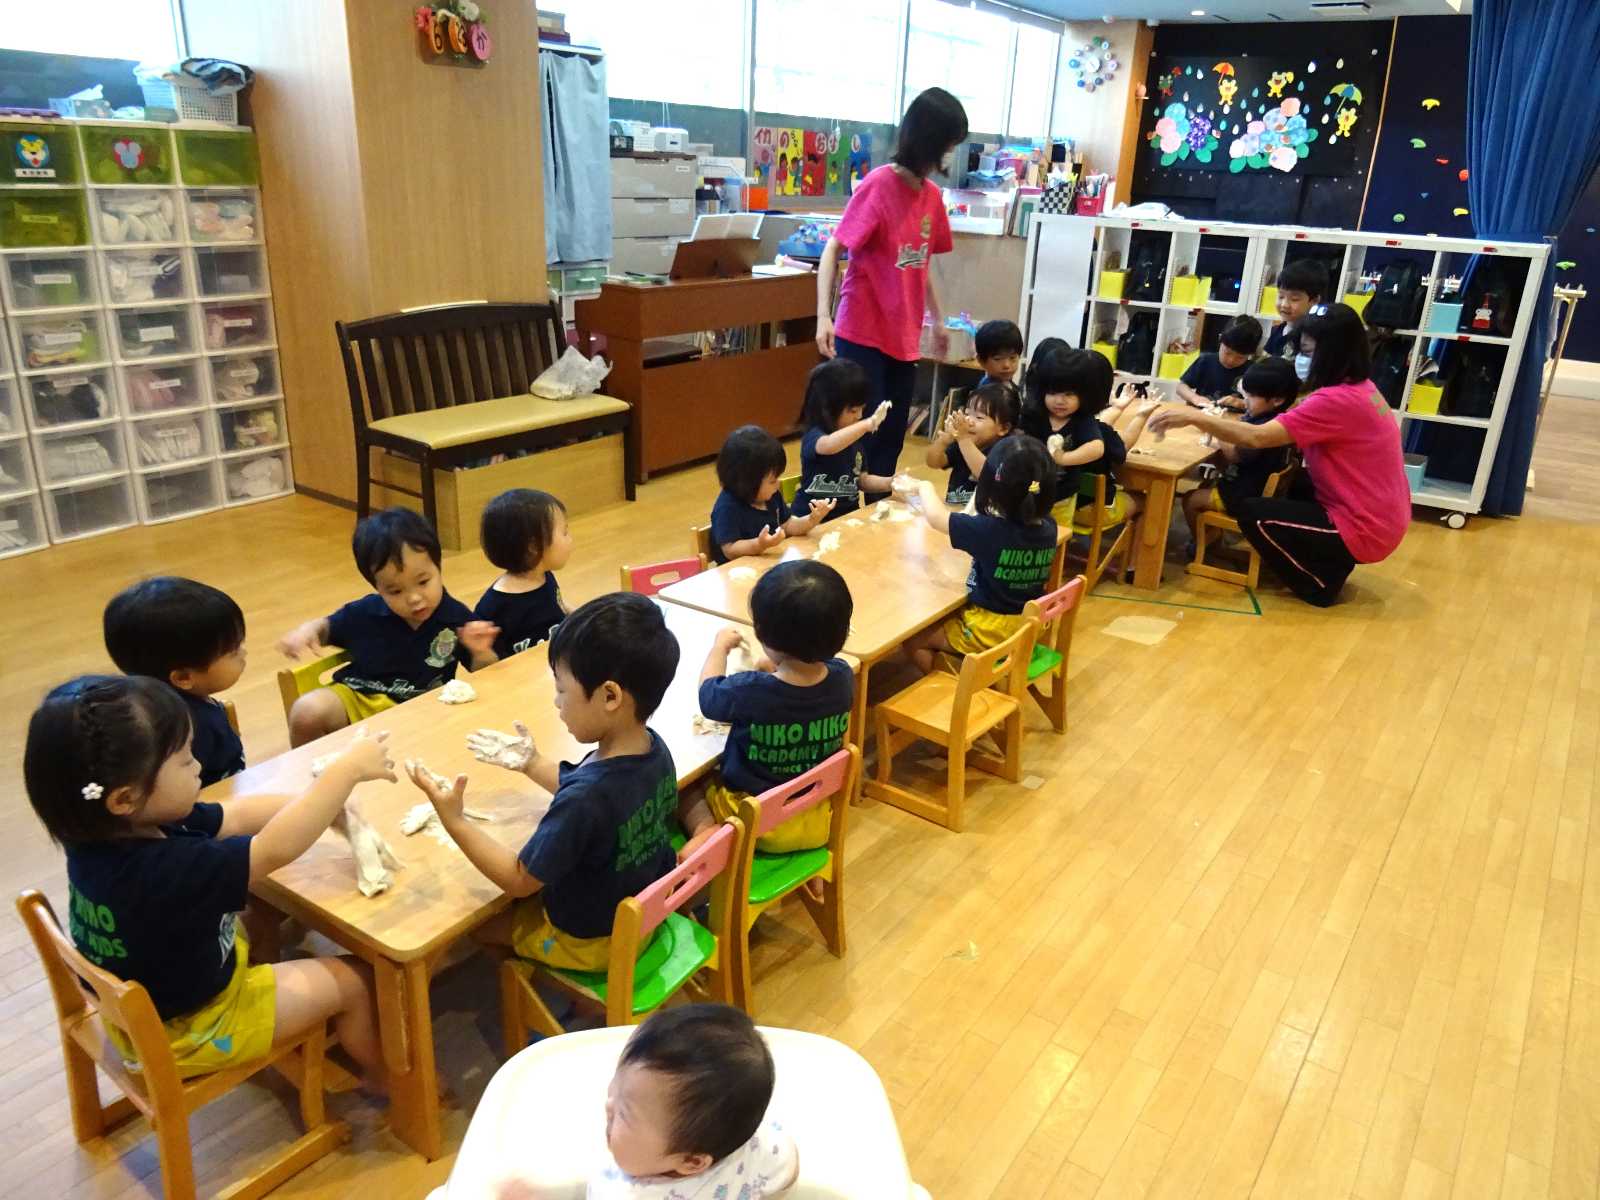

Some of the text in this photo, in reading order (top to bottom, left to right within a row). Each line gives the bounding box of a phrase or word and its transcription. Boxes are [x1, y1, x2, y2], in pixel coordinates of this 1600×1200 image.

[1035, 548, 1057, 565] NIK
[749, 711, 850, 746] NIKO NIKO
[748, 744, 819, 763] ACADEMY
